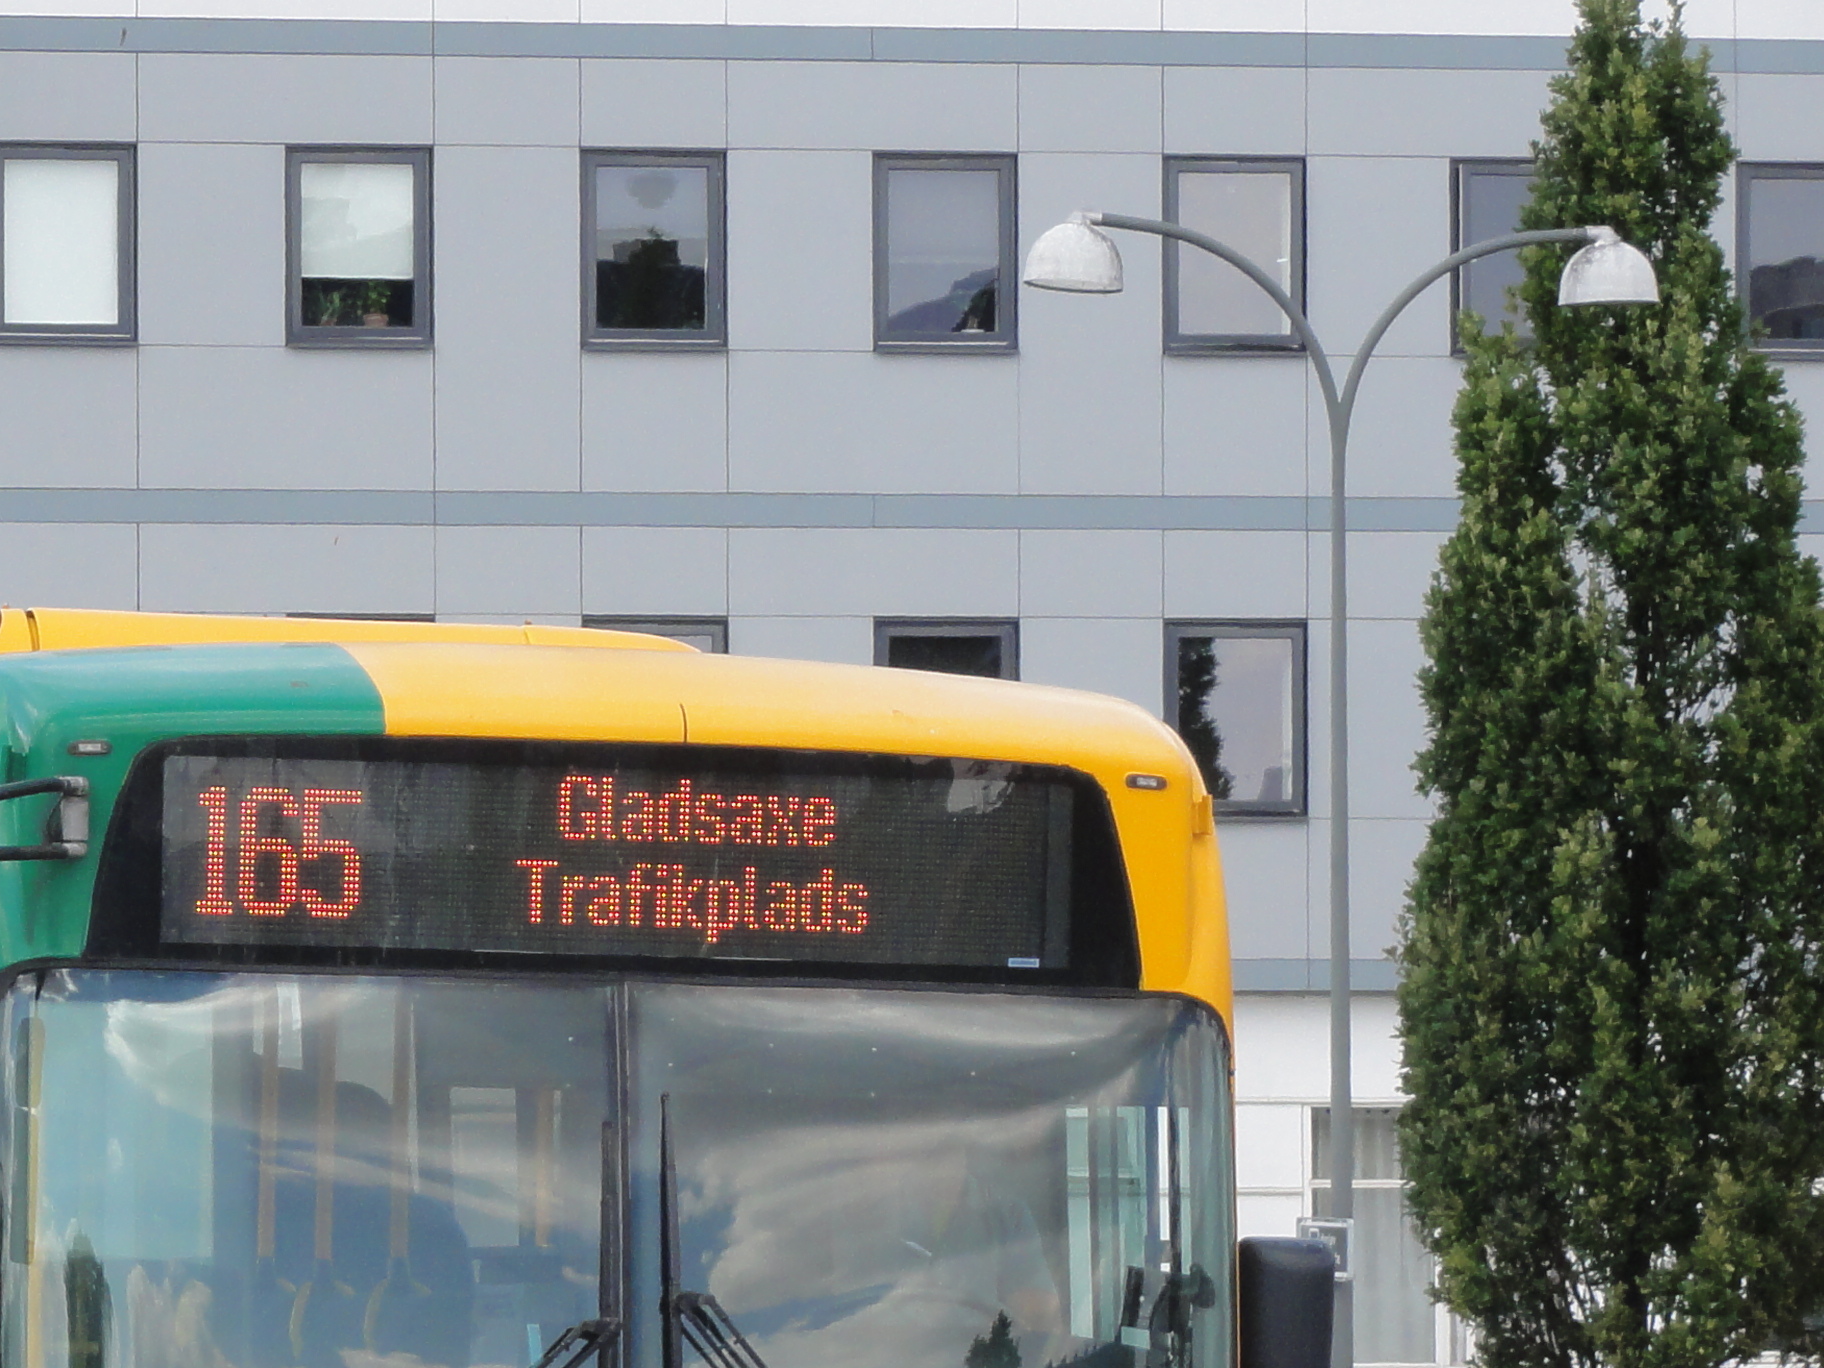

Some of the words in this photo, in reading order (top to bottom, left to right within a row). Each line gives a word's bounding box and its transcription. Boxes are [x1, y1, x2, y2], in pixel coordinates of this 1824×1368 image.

[195, 786, 363, 918] 165
[558, 775, 837, 846] Gladsaxe
[515, 859, 870, 943] Trafikplads
